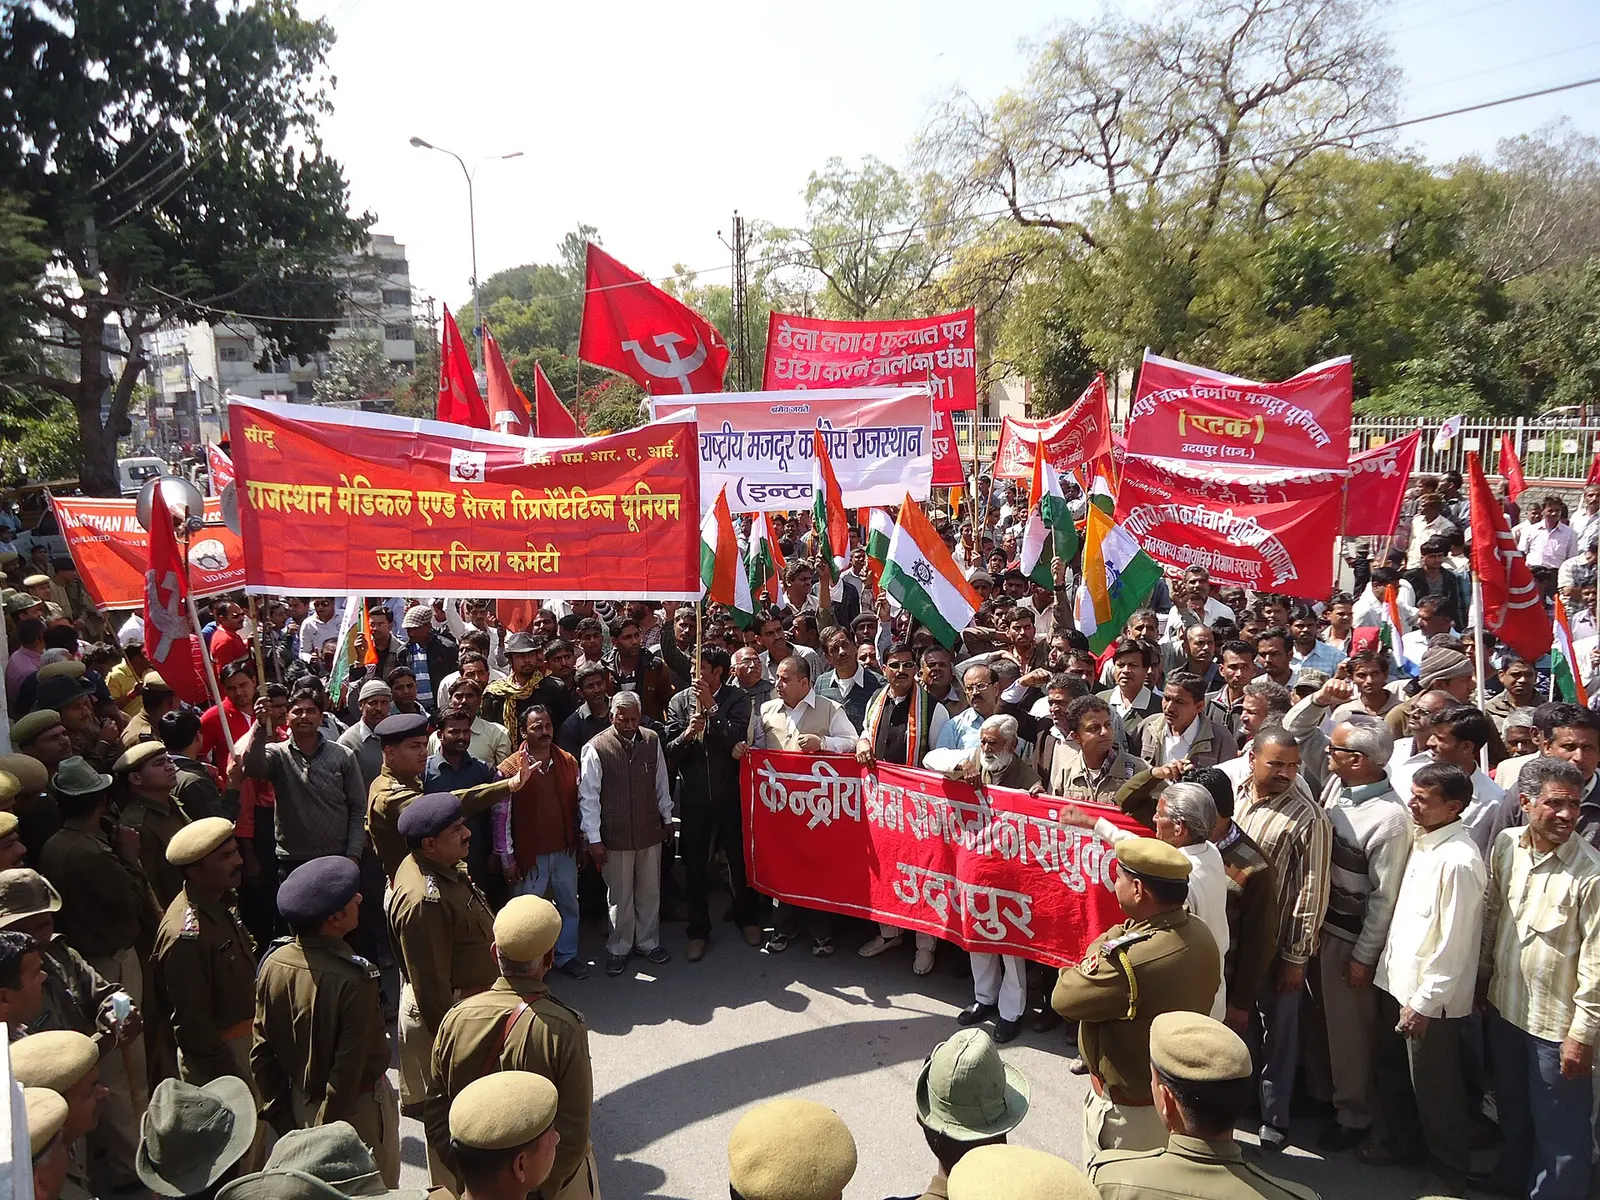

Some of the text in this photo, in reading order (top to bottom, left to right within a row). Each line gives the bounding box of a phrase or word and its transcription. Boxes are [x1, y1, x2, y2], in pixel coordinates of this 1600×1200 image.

[778, 319, 819, 351] ठेला
[940, 320, 967, 341] पर
[823, 355, 872, 381] करने
[244, 424, 275, 450] सीटू
[1244, 391, 1290, 416] मजदूर
[1284, 405, 1332, 448] यूनियन
[626, 446, 643, 462] ए.
[647, 440, 679, 461] आई.
[700, 421, 746, 469] राष्ट्रीय
[747, 429, 796, 473] मजदूर
[852, 426, 924, 460] राजस्थान
[1181, 443, 1256, 460] उदयपुर (राज.)
[246, 479, 333, 515] राजस्थान
[337, 474, 413, 516] मेडिकल
[416, 490, 457, 527] एण्ड
[461, 488, 507, 521] सेल्स
[620, 481, 682, 533] यूनियन
[376, 540, 561, 581] उदयपुर जिला कमेटी
[756, 757, 865, 830] केन्द्रीय
[863, 772, 906, 834] श्रम
[990, 809, 1031, 865] का
[892, 860, 1035, 941] उदयपुर
